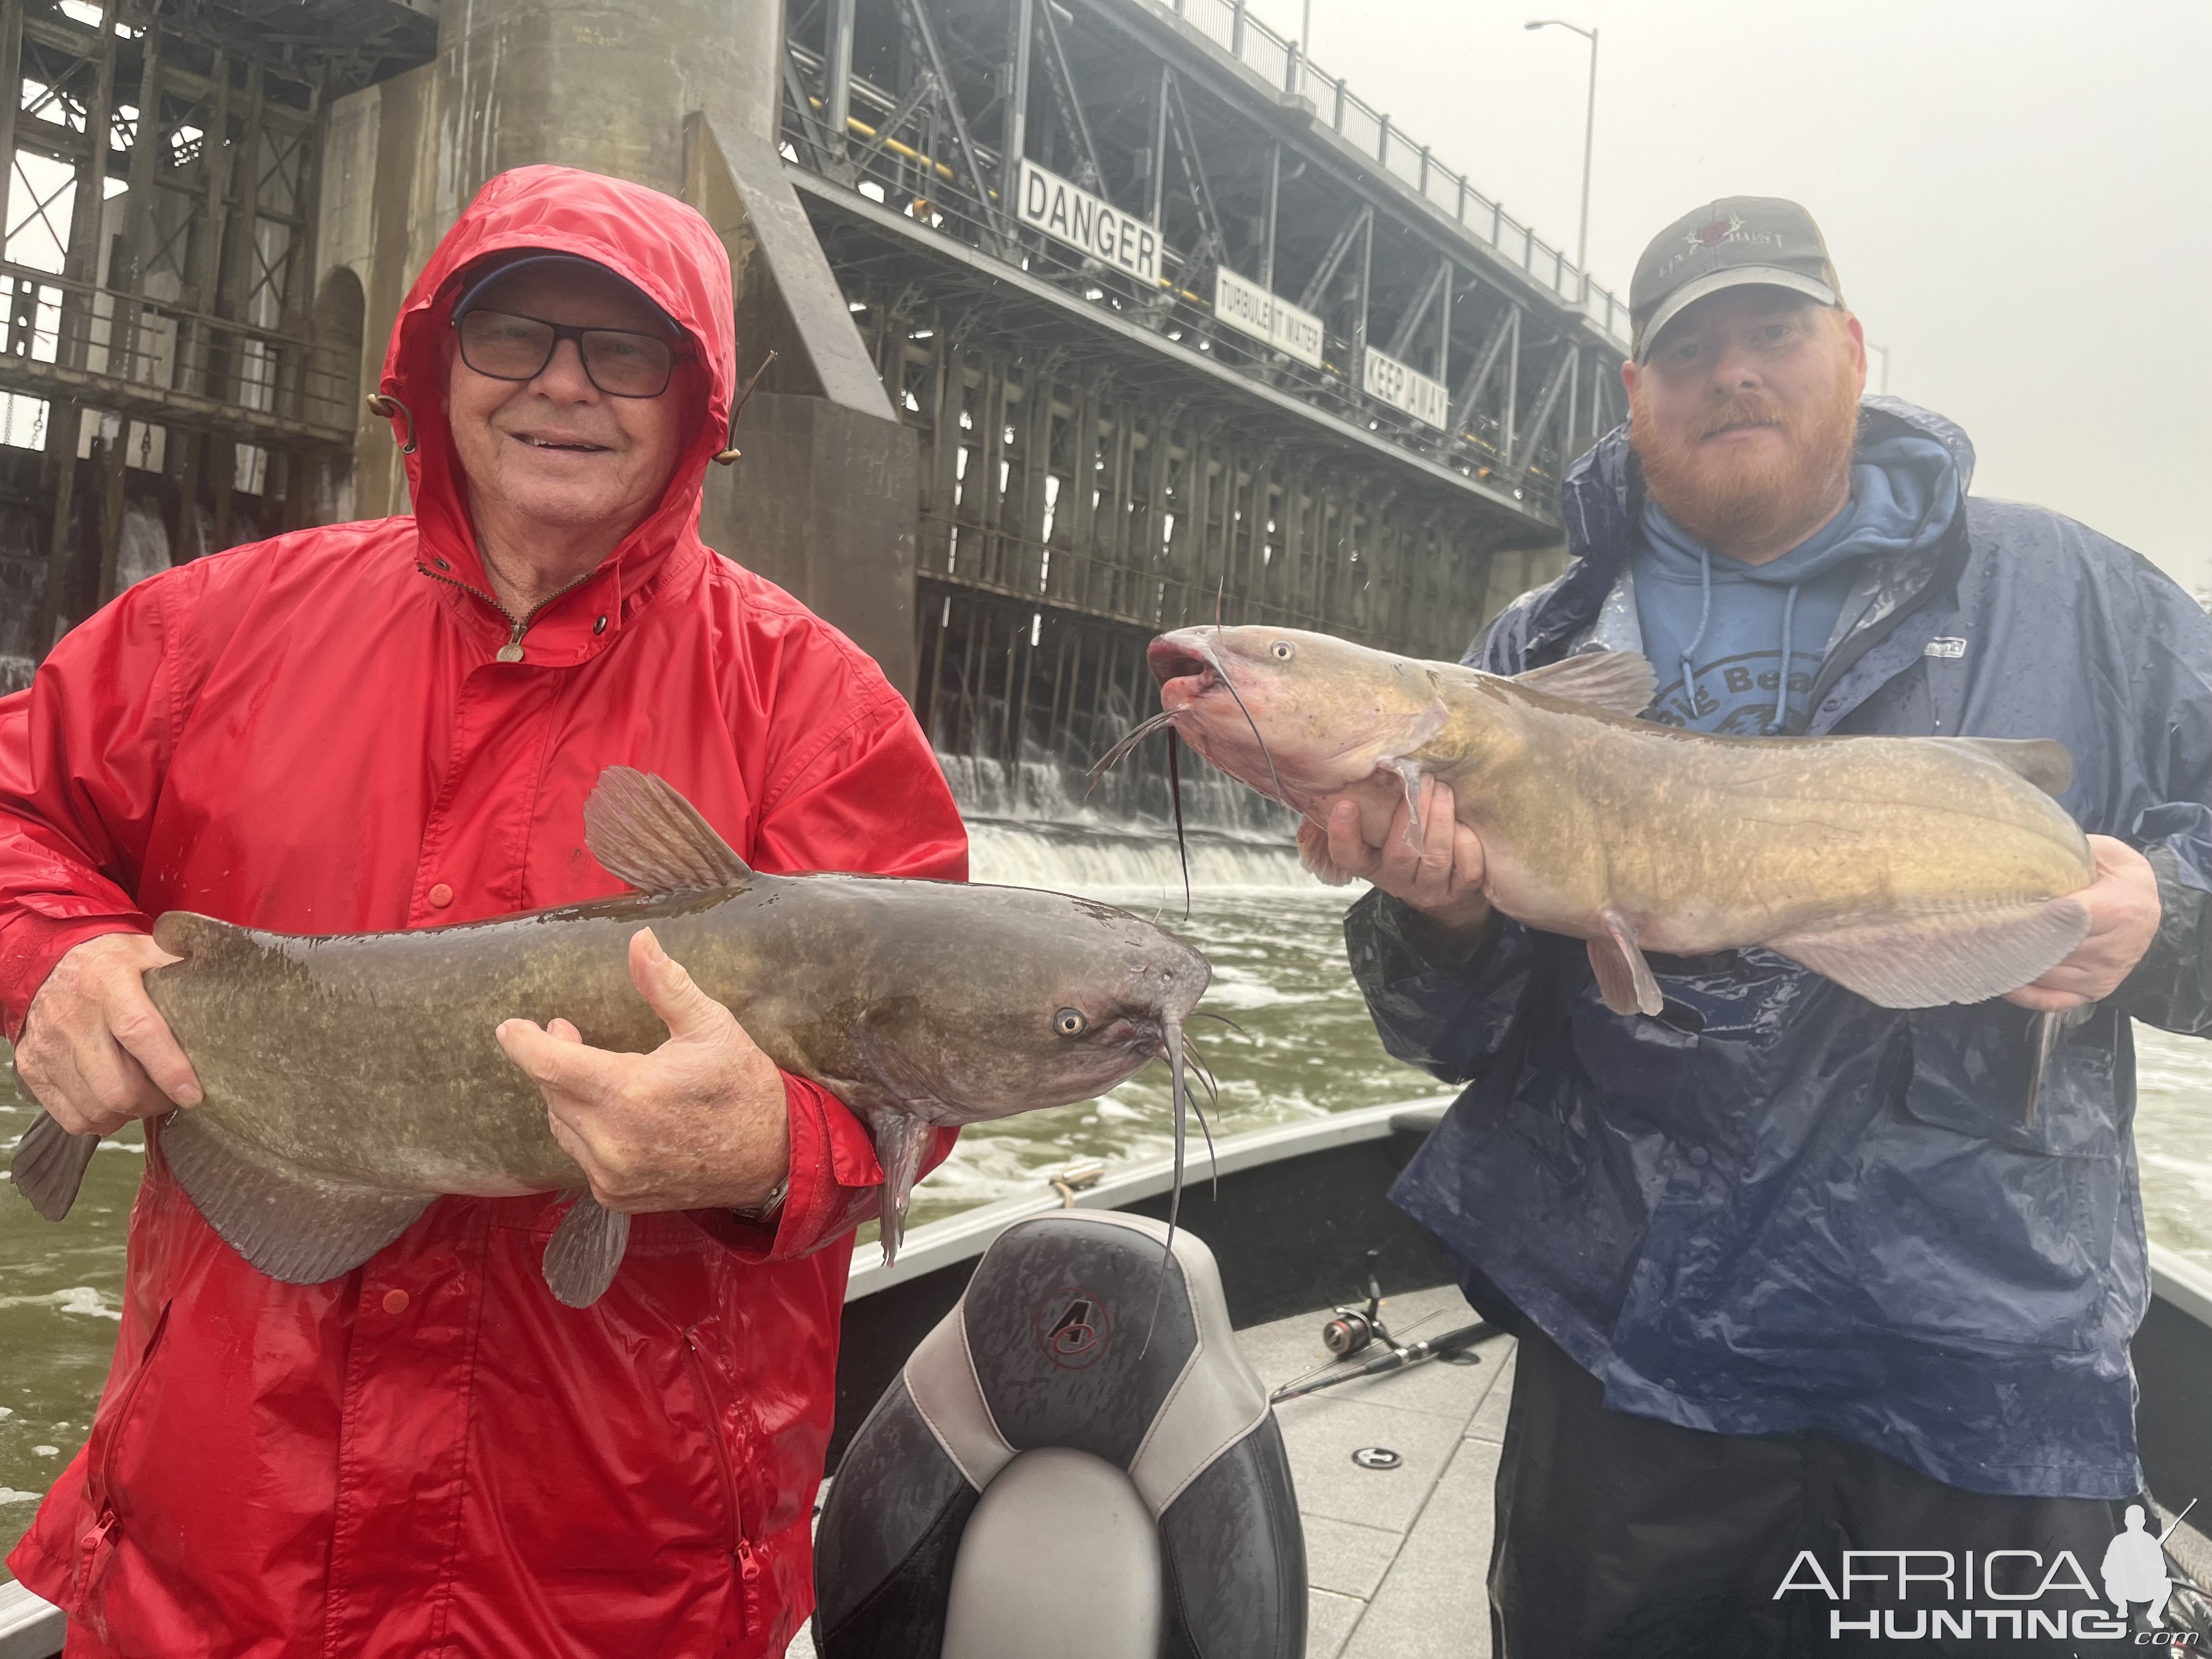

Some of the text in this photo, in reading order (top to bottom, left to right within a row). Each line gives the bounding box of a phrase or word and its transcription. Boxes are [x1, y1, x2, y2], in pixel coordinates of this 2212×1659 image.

[1027, 169, 1154, 279] DANGER
[1221, 279, 1319, 357] TURBULENT WATER
[1367, 354, 1447, 425] KEEP AWAY
